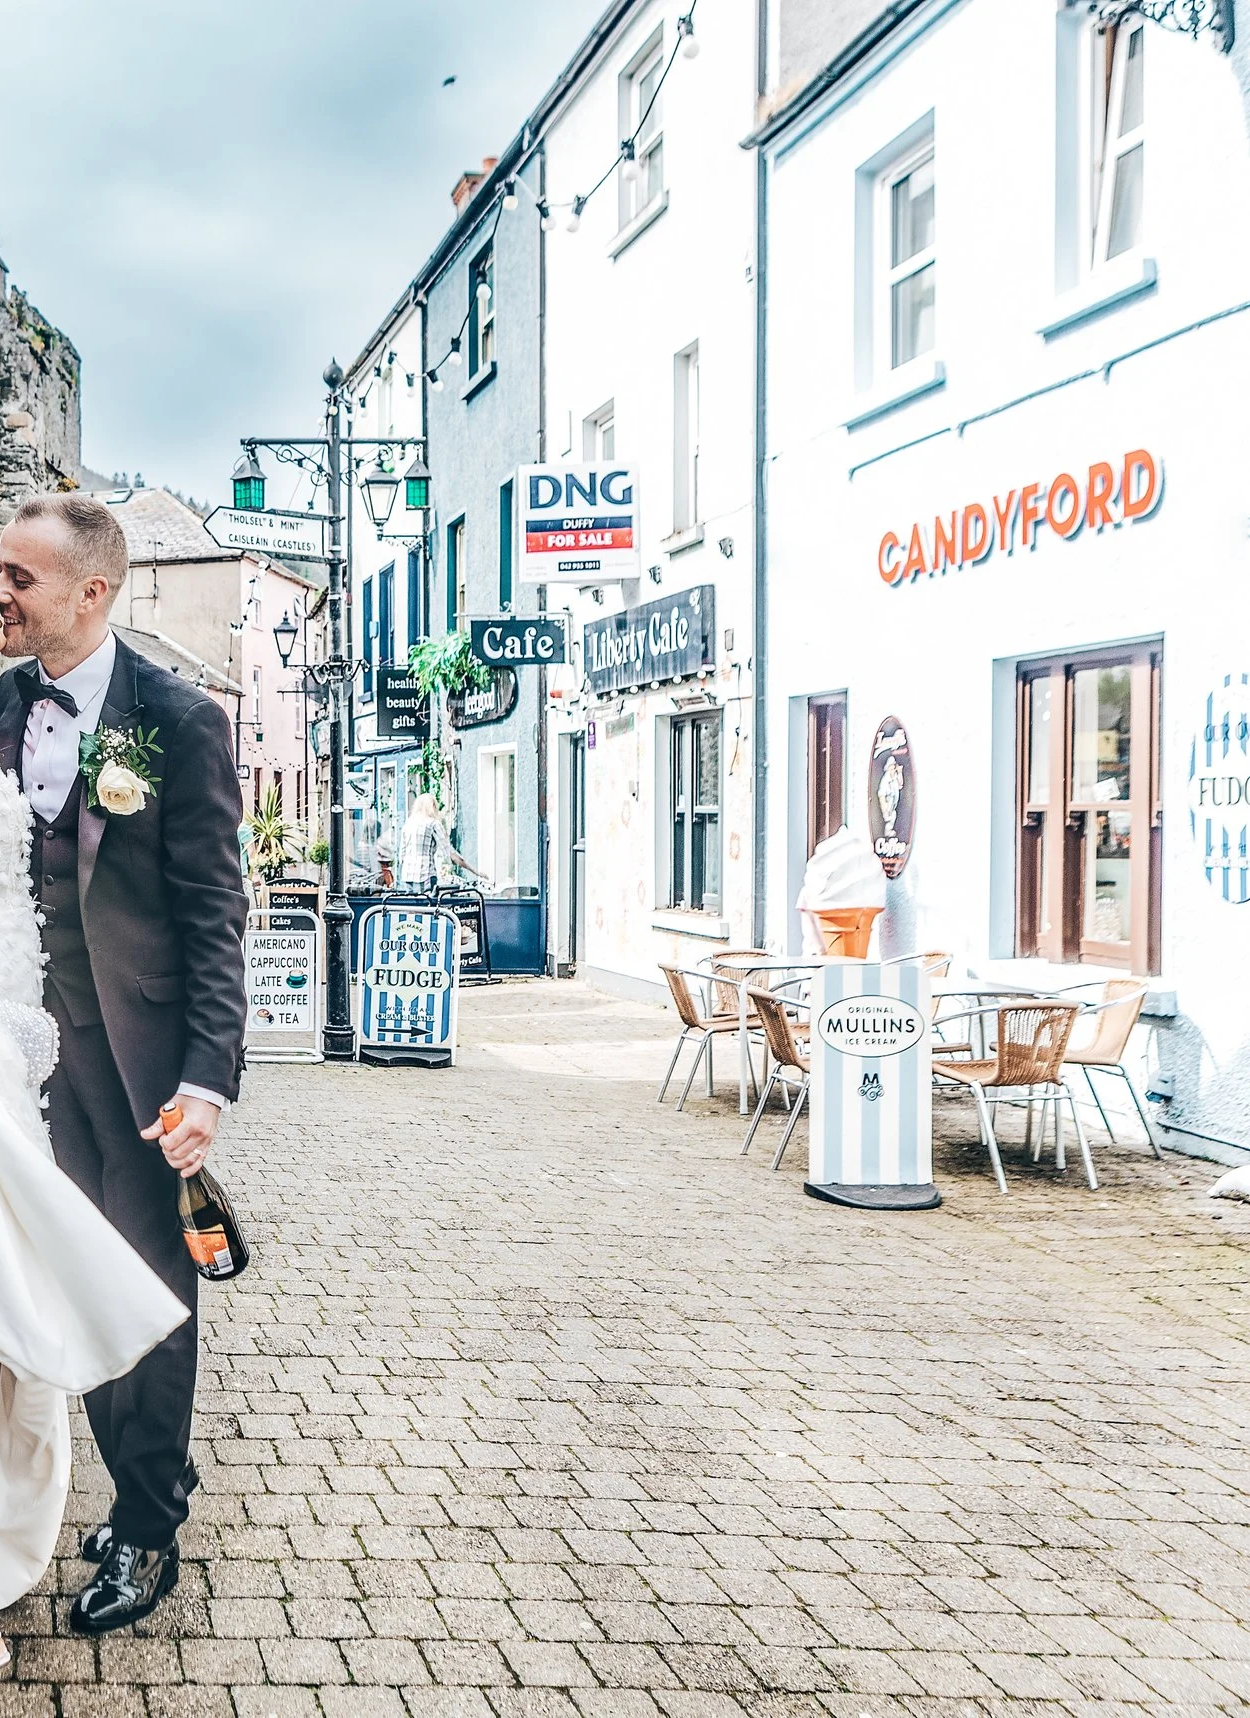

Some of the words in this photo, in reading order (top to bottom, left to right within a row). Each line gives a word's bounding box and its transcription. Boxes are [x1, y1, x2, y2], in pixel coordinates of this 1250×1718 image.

[529, 470, 633, 510] DNG
[268, 518, 274, 528] &
[562, 518, 595, 530] DUFFY
[878, 448, 1163, 587] CANDYFORD
[272, 539, 316, 552] (CASTLES)
[547, 534, 576, 548] FOR
[578, 532, 613, 547] SALE
[482, 626, 554, 660] Cafe
[592, 624, 647, 673] Liberty
[649, 606, 689, 657] Cafe
[387, 676, 420, 690] health
[386, 696, 421, 710] beauty
[392, 715, 416, 730] gifts
[875, 837, 906, 858] Coffee
[271, 895, 300, 904] Coffee's
[271, 917, 291, 926] Cakes
[253, 938, 306, 950] AMERICANO
[380, 939, 407, 952] OUR
[409, 940, 441, 954] OWN
[250, 957, 309, 969] CAPPUCCINO
[255, 975, 282, 987] LATTE
[373, 968, 443, 989] FUDGE
[250, 994, 271, 1005] ICED
[273, 994, 308, 1006] COFFEE
[848, 1006, 895, 1014] ORIGINAL
[278, 1012, 300, 1024] TEA
[827, 1018, 915, 1033] MULLINS
